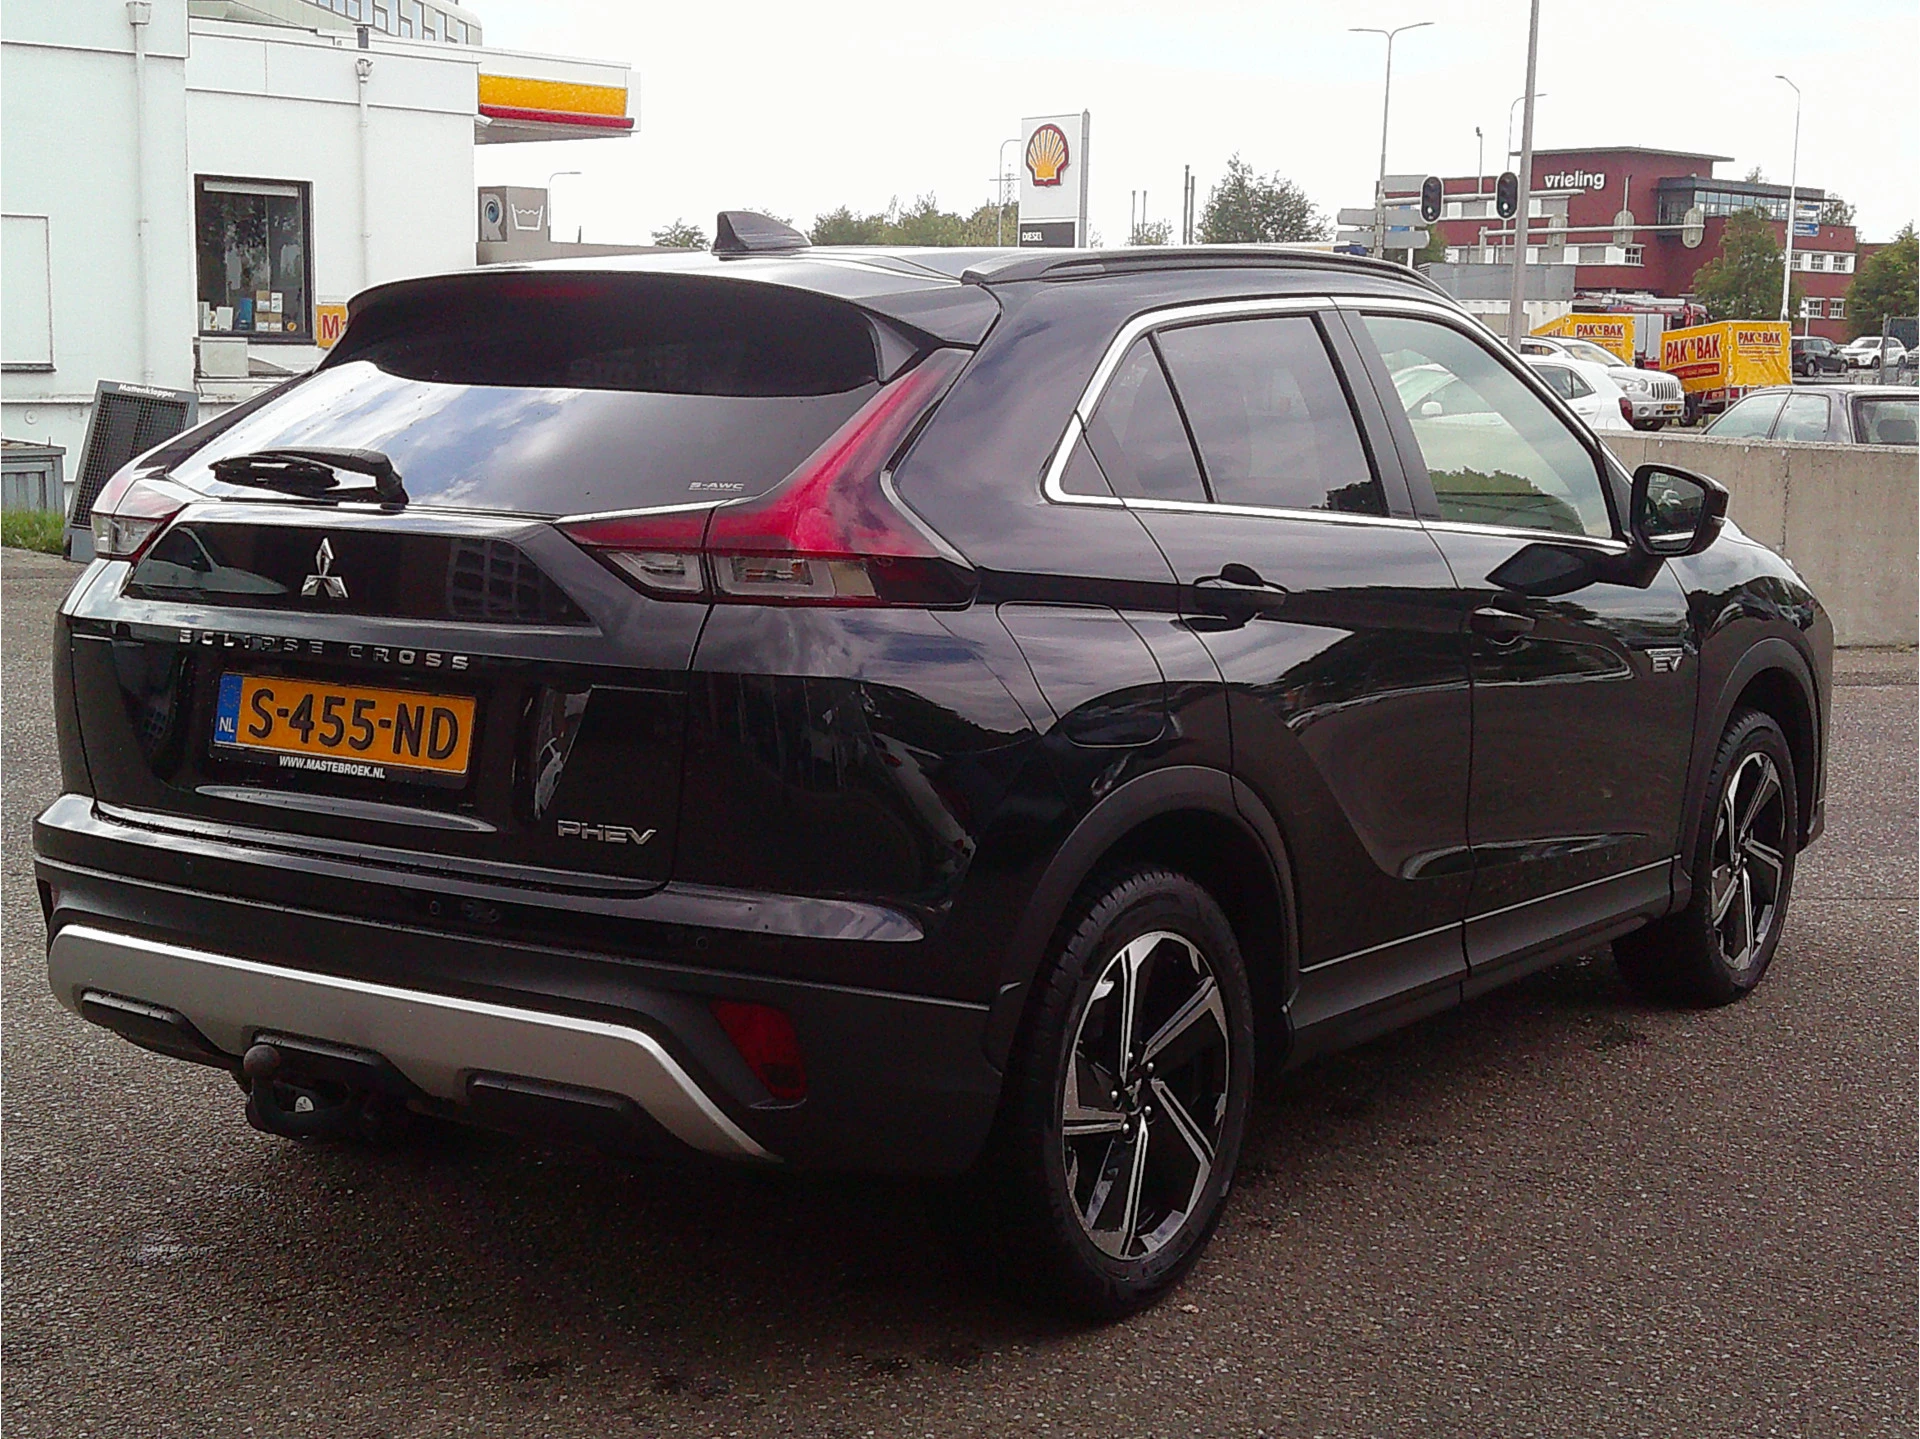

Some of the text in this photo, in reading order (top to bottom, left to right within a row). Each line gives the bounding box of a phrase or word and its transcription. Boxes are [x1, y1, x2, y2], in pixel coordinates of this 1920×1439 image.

[1544, 170, 1605, 190] vrieling
[1022, 232, 1043, 241] DIESEL
[322, 314, 347, 339] M
[1577, 324, 1596, 337] PAK
[1604, 324, 1623, 336] BAK
[1738, 332, 1755, 344] PAK
[1763, 332, 1781, 344] BAK
[1666, 339, 1688, 366] PAK
[1697, 334, 1720, 360] BAK
[118, 383, 177, 398] Mattenklapper
[179, 628, 470, 671] ECLIPSE CROSS
[1652, 655, 1683, 673] EV
[218, 716, 236, 734] NL
[247, 688, 459, 760] S-455-ND
[279, 755, 386, 779] WWW.MASTEBROEK.NL
[557, 819, 657, 845] PHEV
